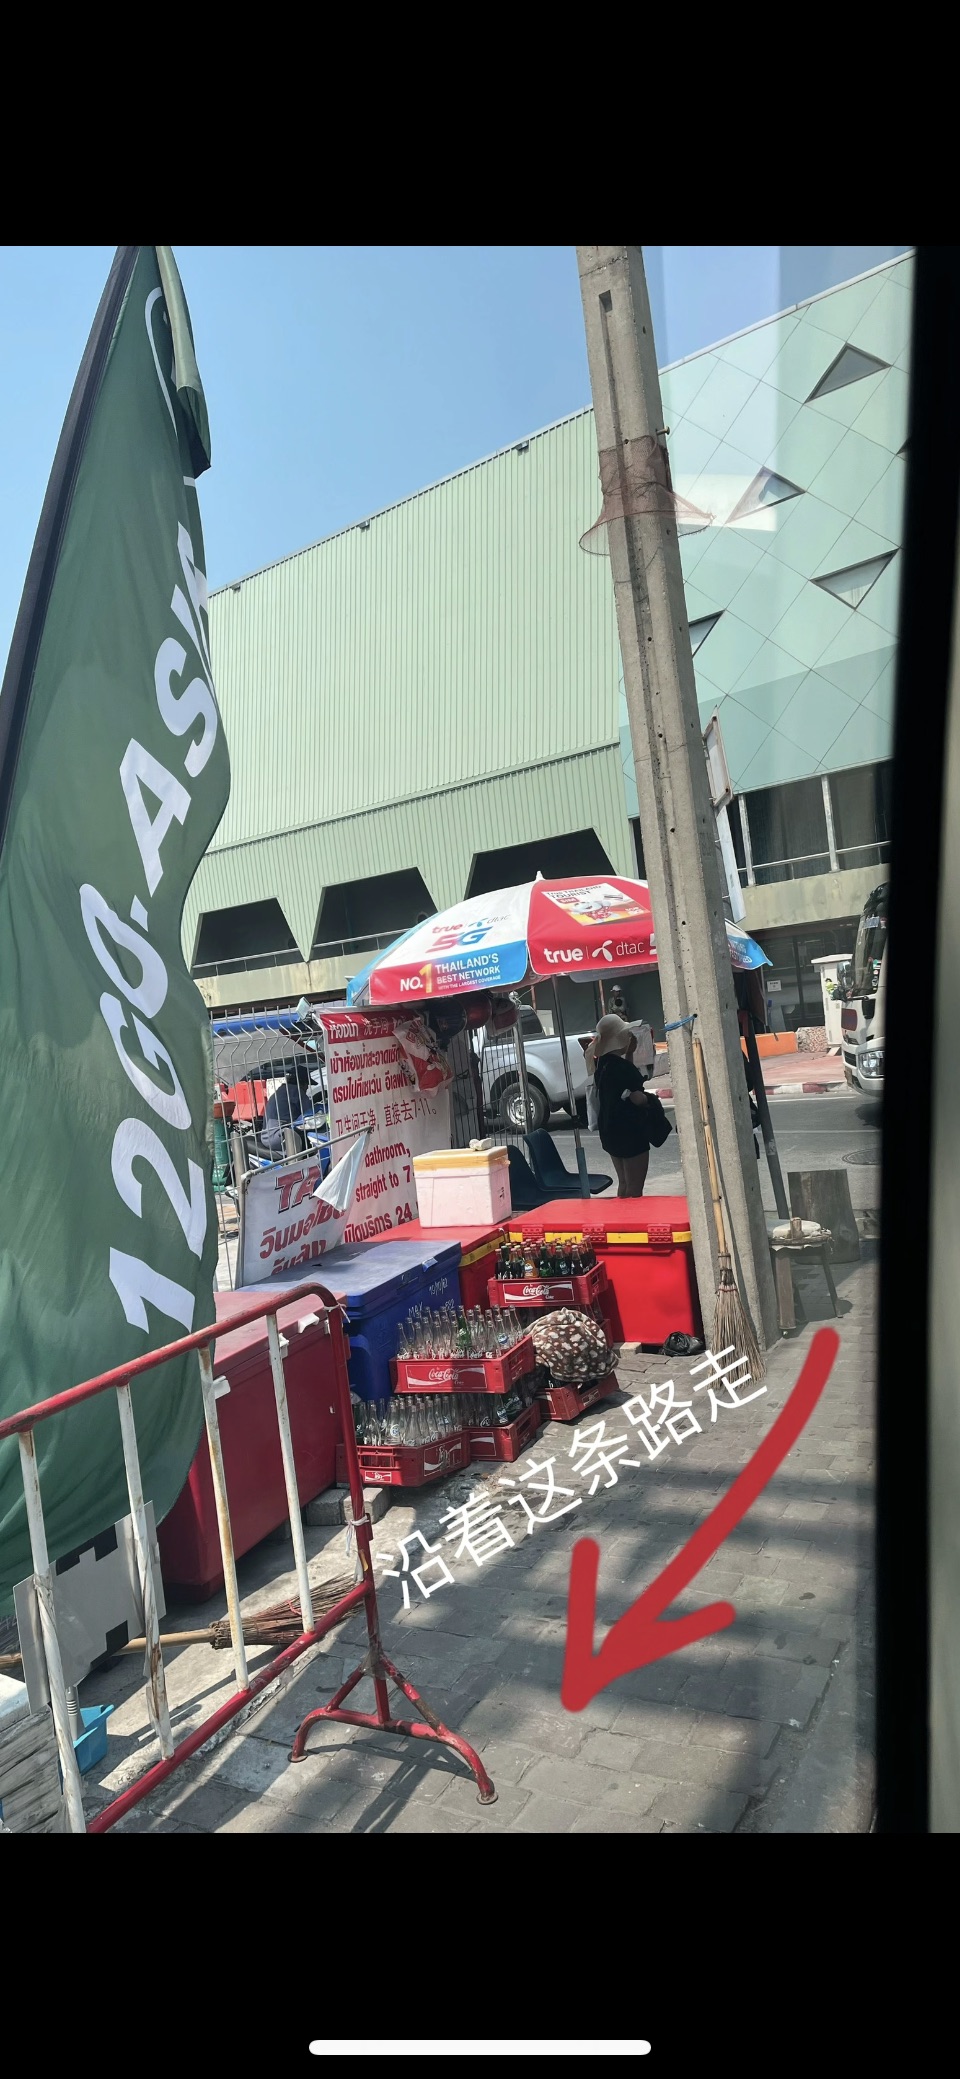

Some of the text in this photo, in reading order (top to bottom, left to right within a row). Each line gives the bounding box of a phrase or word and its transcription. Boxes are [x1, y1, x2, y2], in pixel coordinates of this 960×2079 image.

[551, 890, 592, 899] TOURIST
[432, 914, 511, 934] true dtac
[425, 926, 494, 954] 5G
[543, 947, 584, 964] true
[615, 941, 646, 957] dtac
[434, 953, 500, 975] THAILAND'S
[437, 965, 501, 985] BEST NETWORK
[449, 981, 459, 989] THE
[459, 979, 479, 988] LARGEST
[478, 974, 502, 985] COVERAGE
[356, 1174, 388, 1202] straight
[389, 1171, 399, 1188] to
[395, 1202, 412, 1225] 24
[522, 1284, 550, 1296] Coca-Cola
[428, 1368, 459, 1381] Coca-Cola
